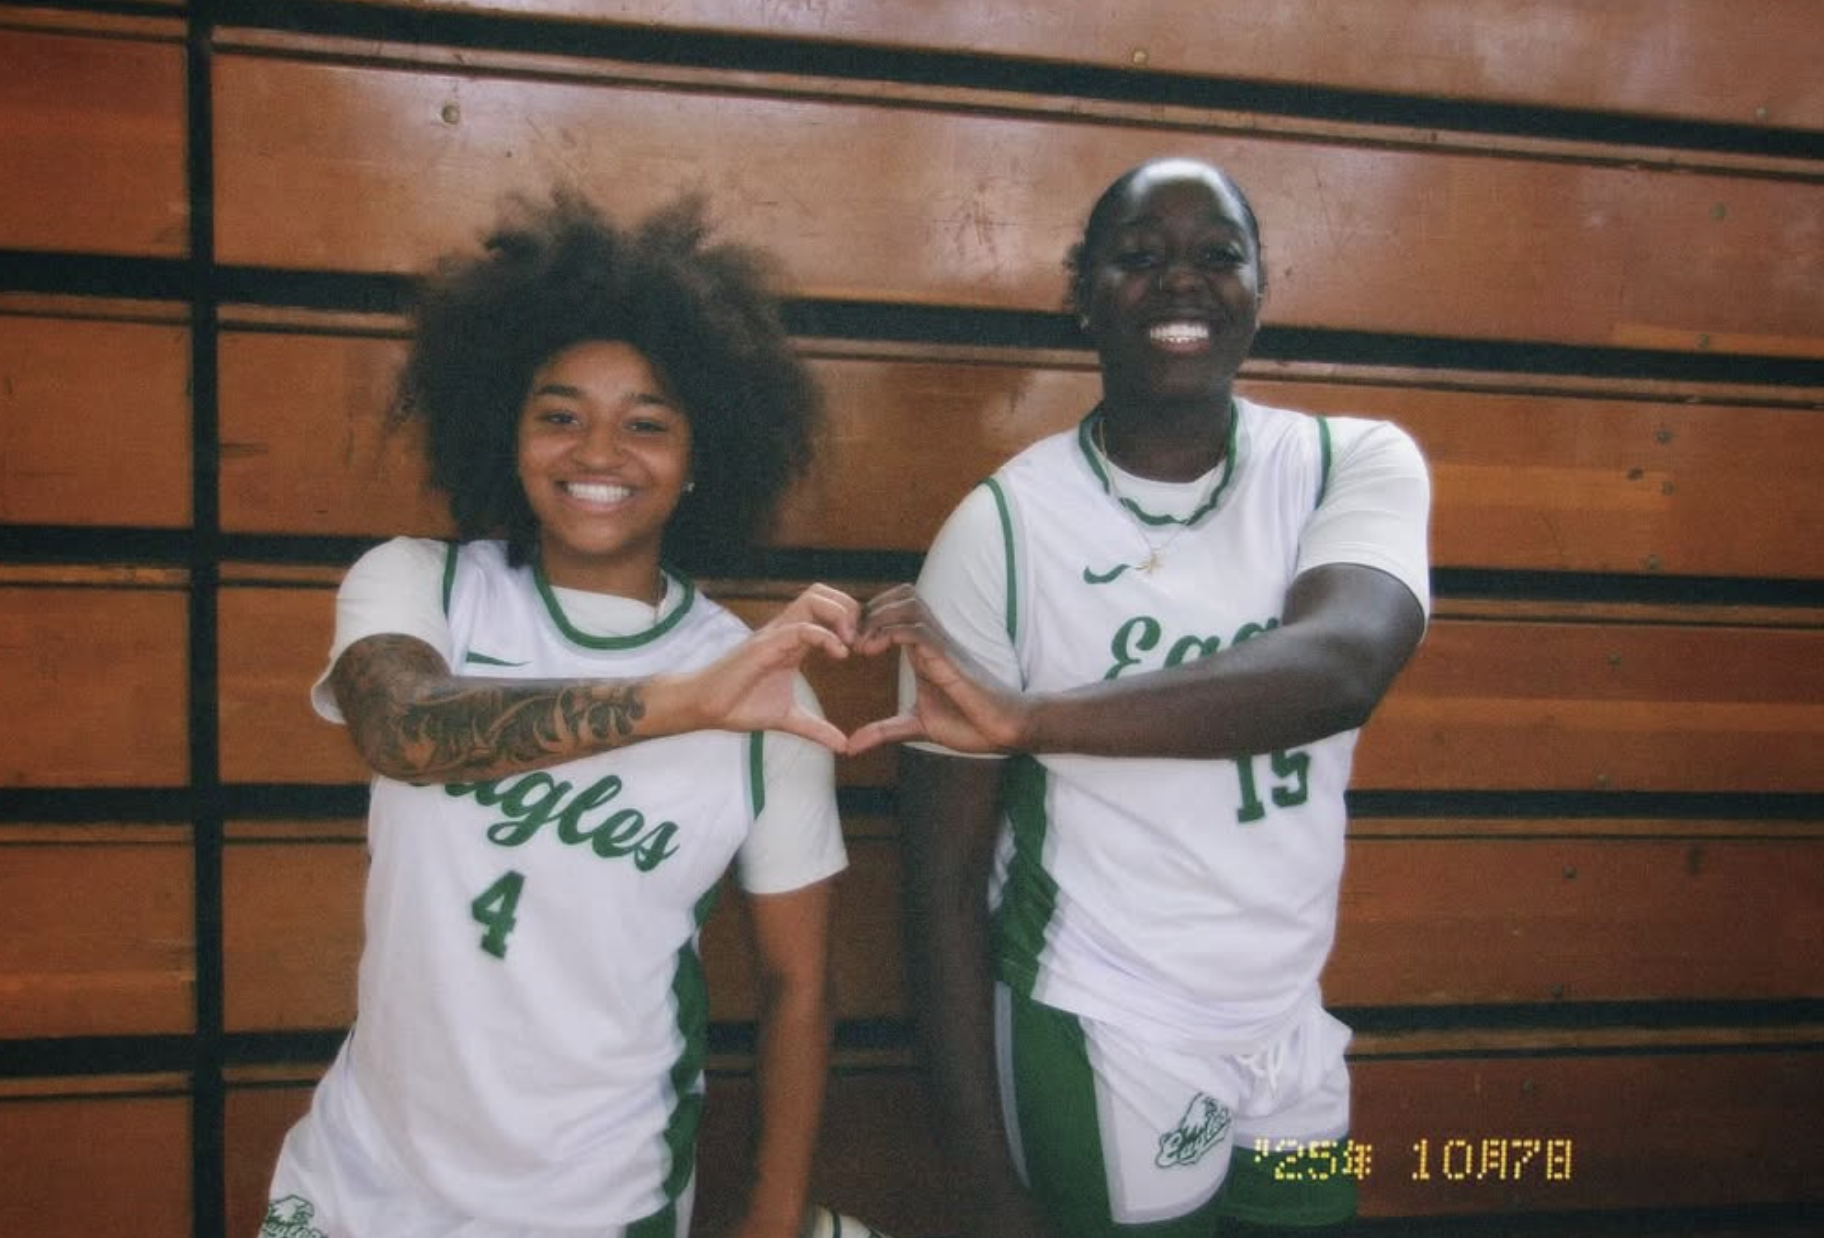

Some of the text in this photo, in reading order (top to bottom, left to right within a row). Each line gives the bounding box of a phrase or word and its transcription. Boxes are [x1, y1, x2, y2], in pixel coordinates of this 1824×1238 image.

[407, 771, 680, 872] agles
[1236, 749, 1310, 824] 15
[471, 870, 526, 959] 4
